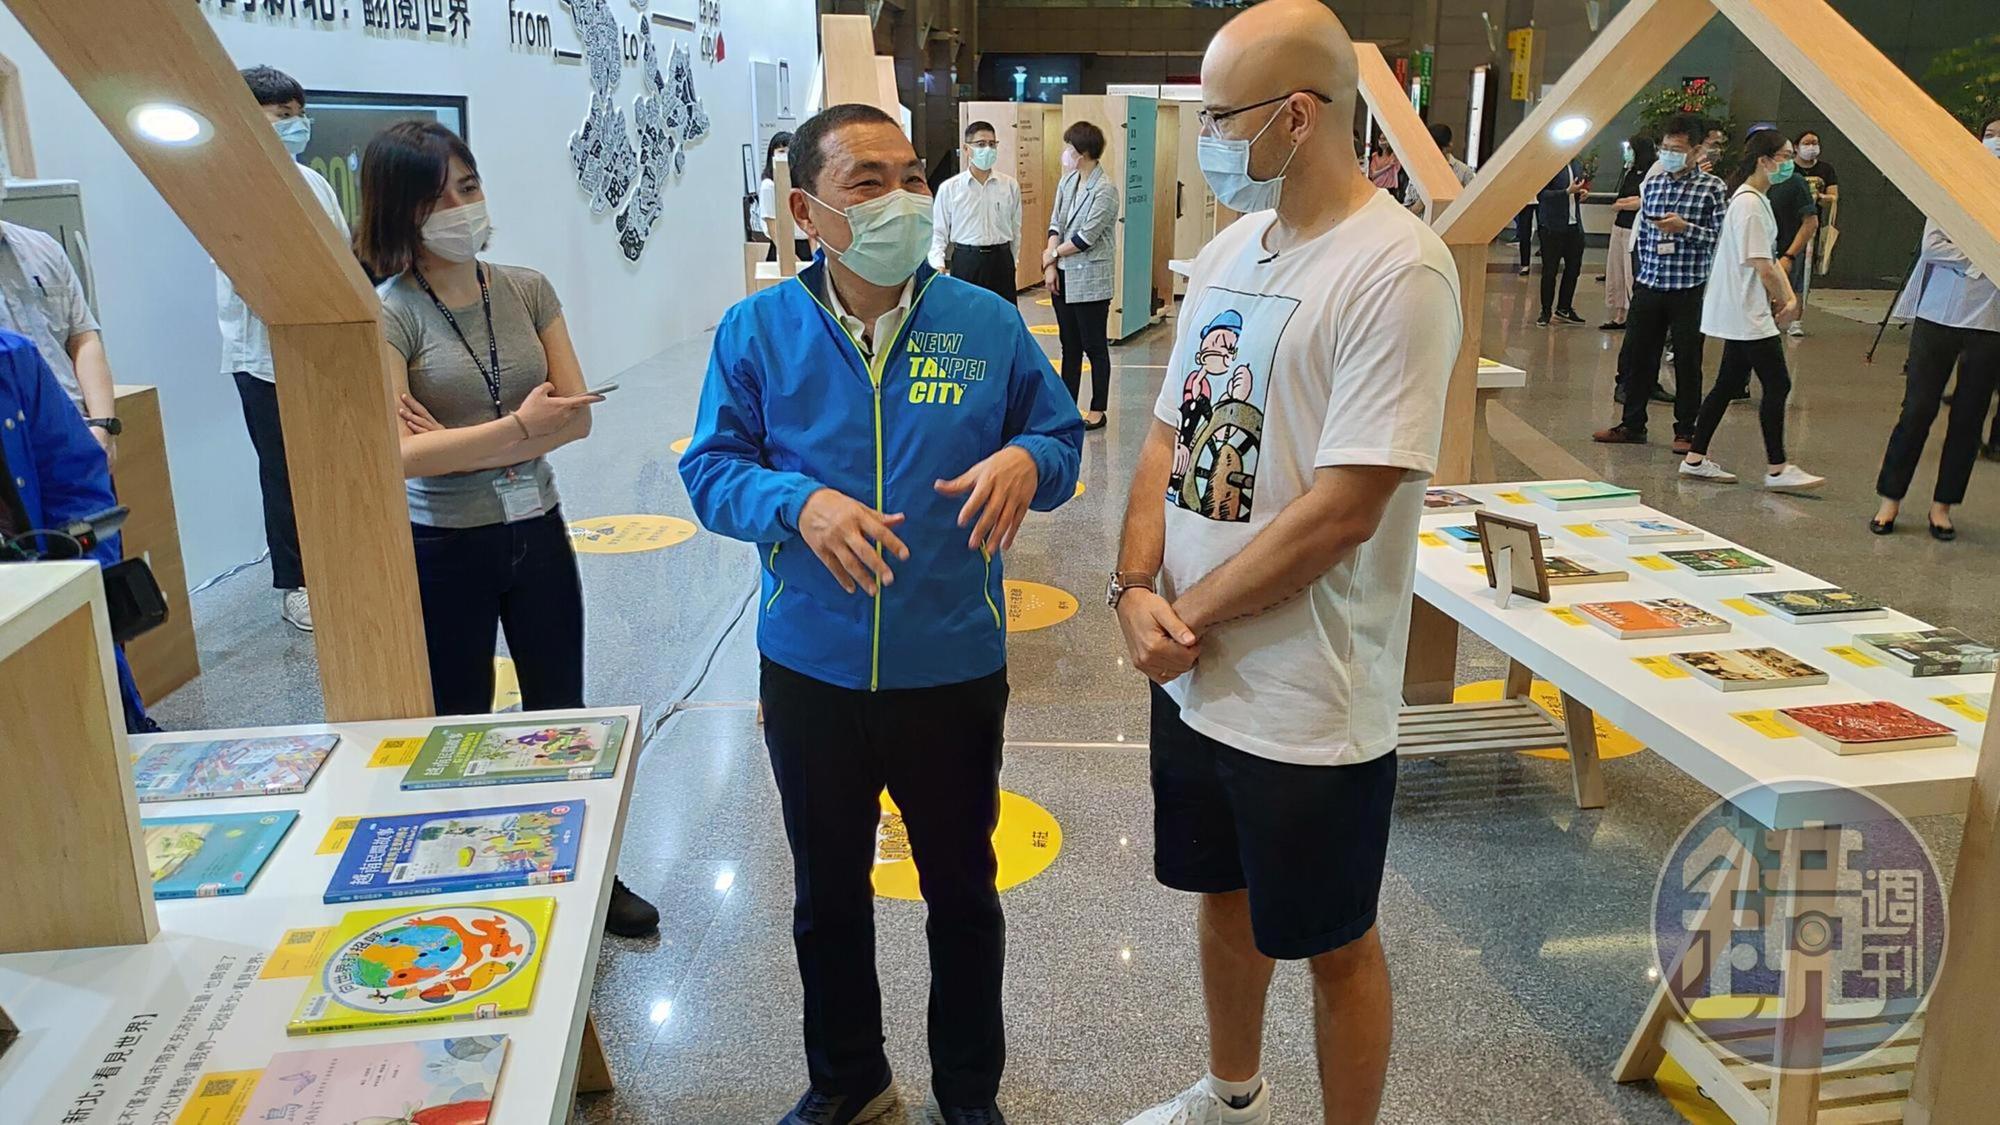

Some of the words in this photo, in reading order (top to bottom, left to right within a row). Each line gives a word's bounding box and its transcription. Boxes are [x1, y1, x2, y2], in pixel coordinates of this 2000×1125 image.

[508, 0, 552, 48] from
[622, 26, 638, 61] to
[906, 330, 963, 354] NEW
[909, 356, 986, 381] TAIPEI
[908, 381, 967, 405] CITY
[350, 827, 395, 886] 越南民間故事
[333, 930, 384, 995] 向世界打招呼
